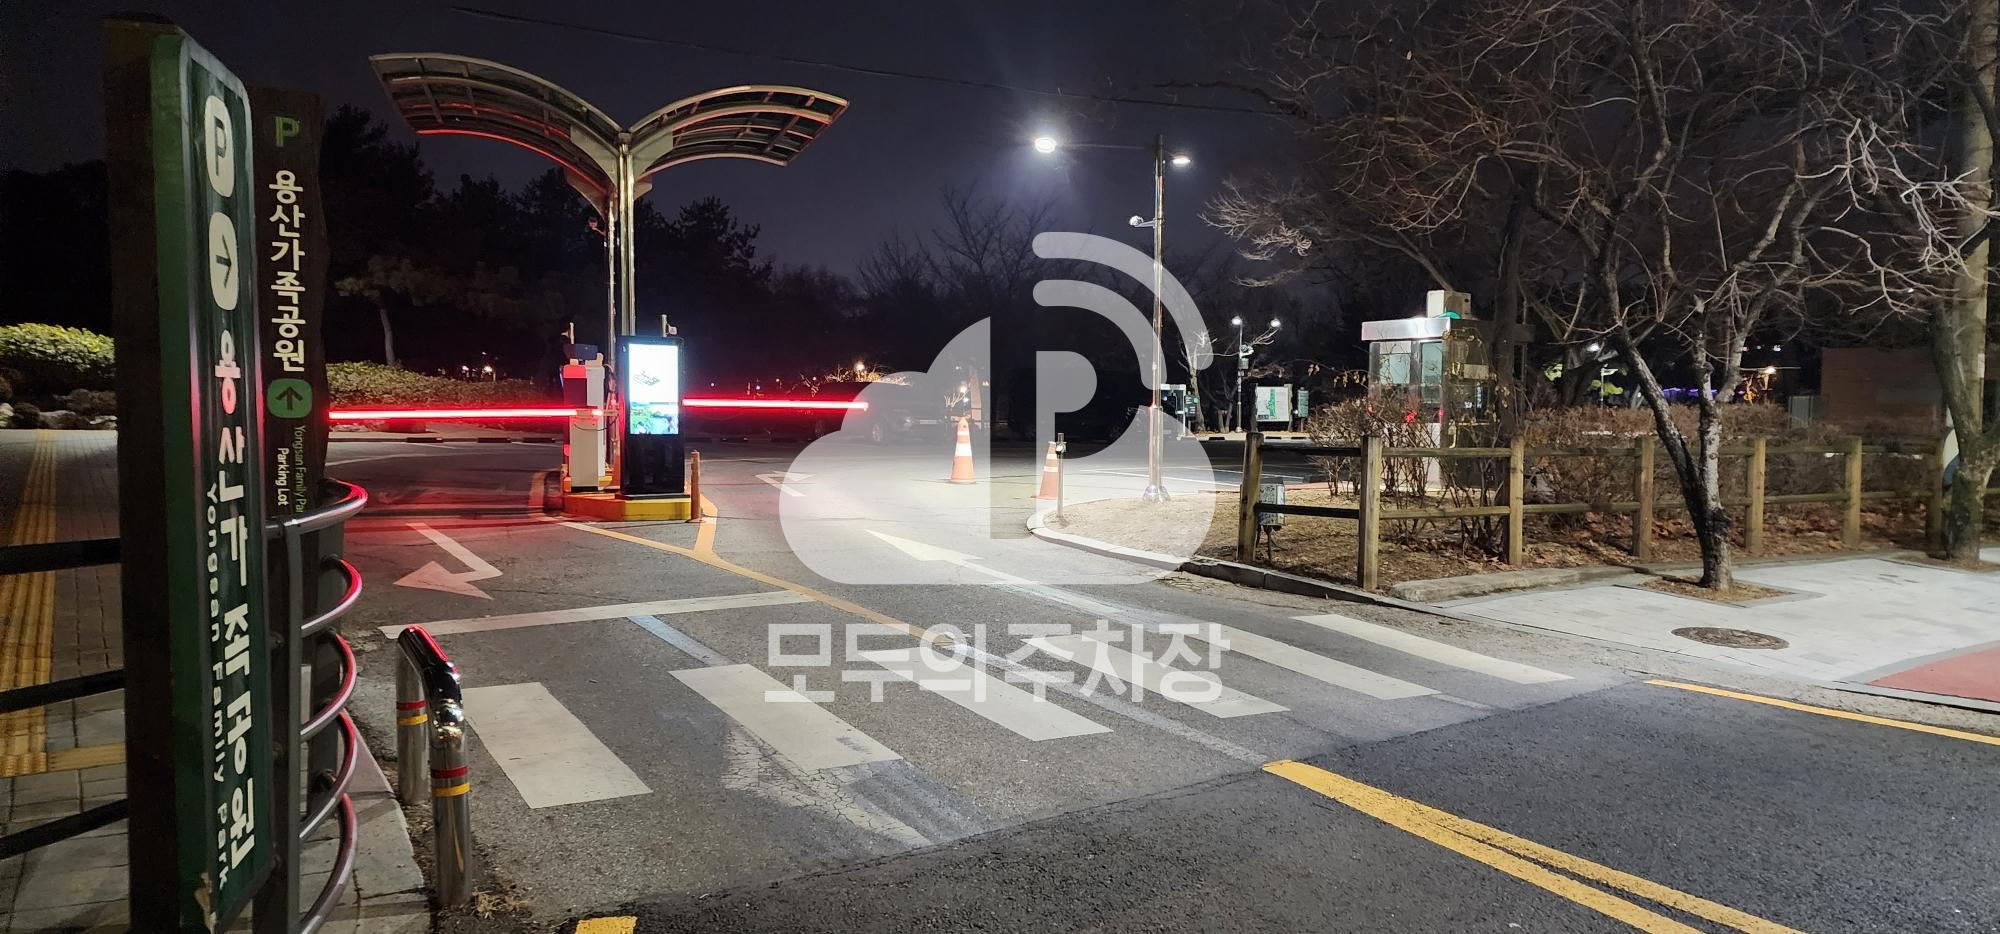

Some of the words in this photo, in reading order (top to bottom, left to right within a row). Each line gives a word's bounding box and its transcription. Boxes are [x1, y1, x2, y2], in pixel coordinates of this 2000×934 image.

[213, 114, 227, 177] P
[275, 116, 300, 148] P
[268, 169, 306, 373] 용산가족공원
[275, 447, 290, 486] Parking
[292, 425, 306, 466] Yongsan
[277, 488, 290, 506] Lot
[293, 467, 307, 498] Family
[206, 482, 221, 642] Yongsan
[214, 329, 255, 870] 용산가족공원
[212, 661, 227, 783] Family
[217, 802, 230, 891] Park
